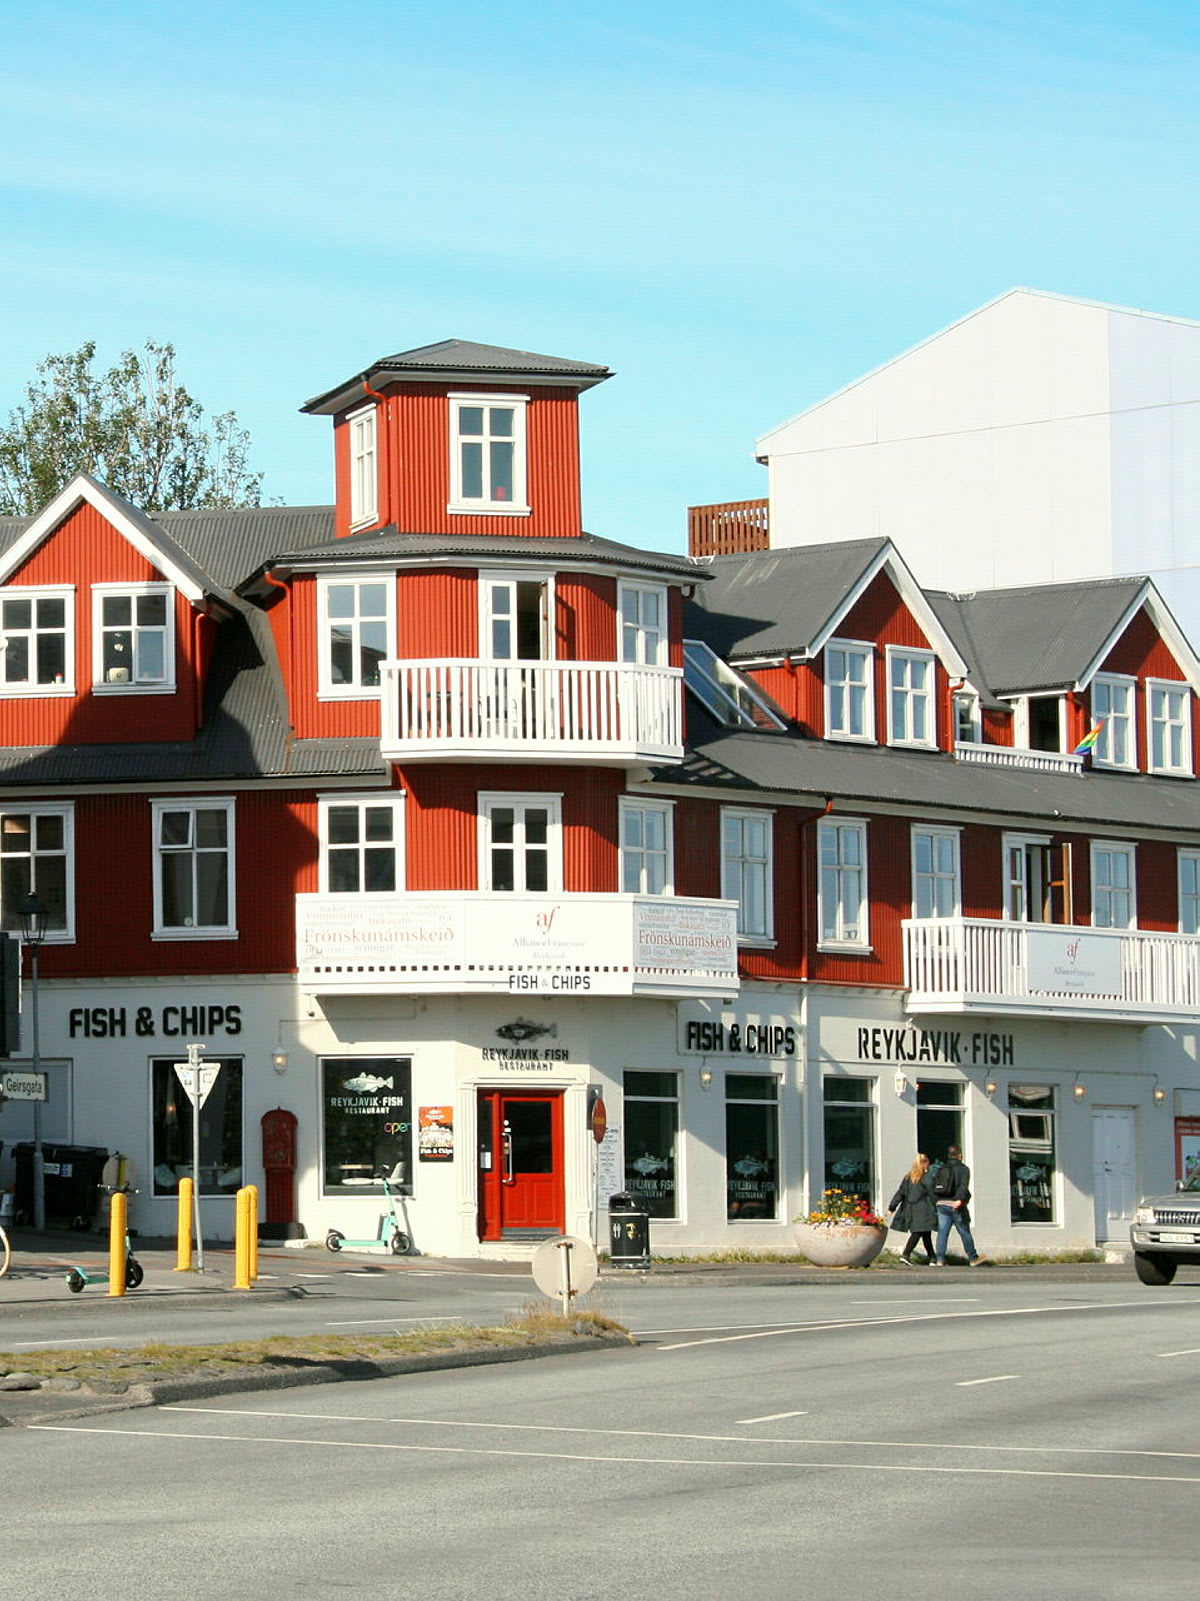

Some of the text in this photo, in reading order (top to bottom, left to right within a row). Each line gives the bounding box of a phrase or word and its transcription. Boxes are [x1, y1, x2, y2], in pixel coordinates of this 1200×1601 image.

[509, 974, 538, 990] FISH
[551, 974, 591, 990] CHIPS
[69, 1005, 241, 1037] FISH & CHIPS
[687, 1021, 795, 1055] FISH & CHIPS
[857, 1027, 1014, 1065] REYKJAVIK FISH
[482, 1047, 569, 1061] REYKJAVIK FISH
[6, 1078, 43, 1096] Geirsgata
[330, 1096, 404, 1107] REYKJAVIK FISH
